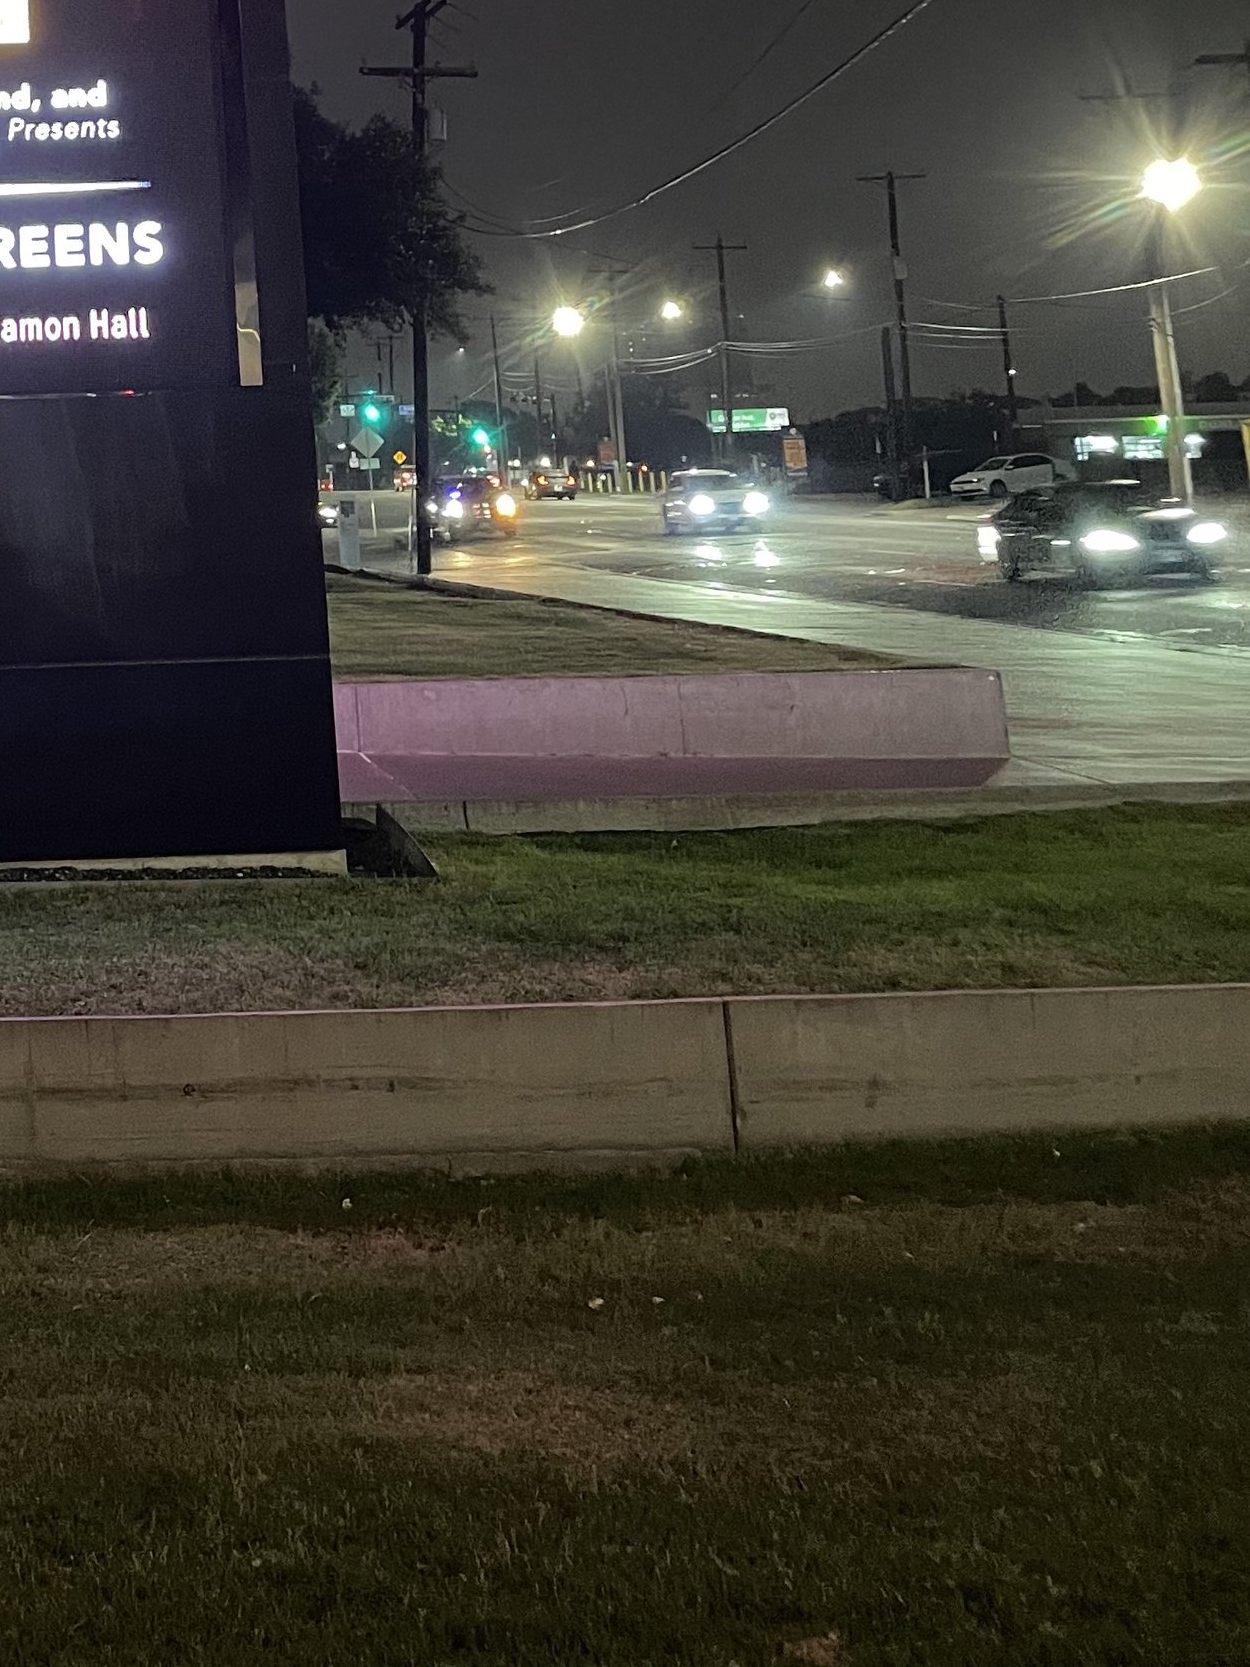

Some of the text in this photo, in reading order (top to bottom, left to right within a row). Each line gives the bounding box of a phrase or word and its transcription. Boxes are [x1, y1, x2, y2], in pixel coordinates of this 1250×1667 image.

[50, 79, 108, 109] and
[7, 116, 121, 142] Presents
[89, 306, 150, 340] Hall
